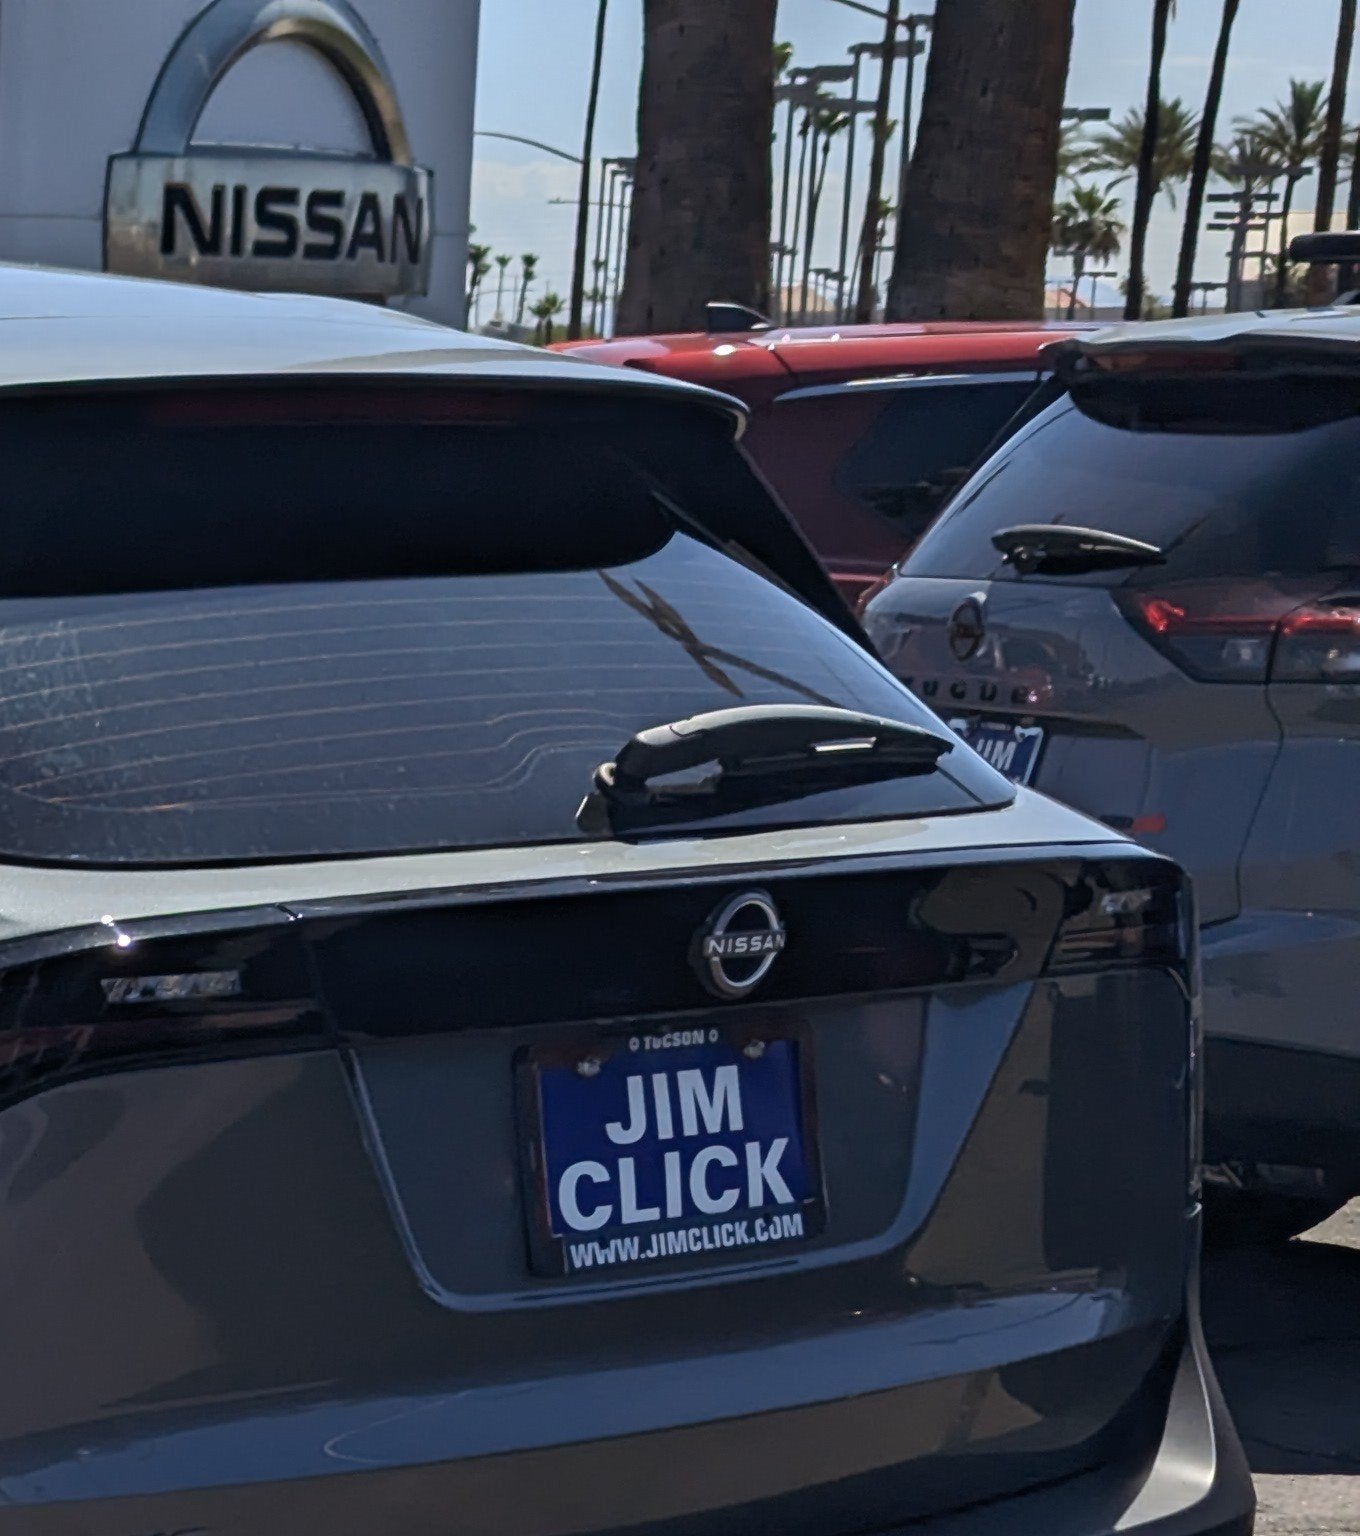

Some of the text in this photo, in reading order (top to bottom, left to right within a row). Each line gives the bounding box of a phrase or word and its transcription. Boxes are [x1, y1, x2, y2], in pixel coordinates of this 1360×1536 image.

[160, 183, 424, 265] NISSAN
[707, 933, 785, 954] NISSAN
[643, 1029, 705, 1051] TUCSON
[605, 1064, 744, 1146] JIM
[558, 1136, 796, 1233] CLICK
[570, 1212, 804, 1269] WWW.JIMCLICK.COM
